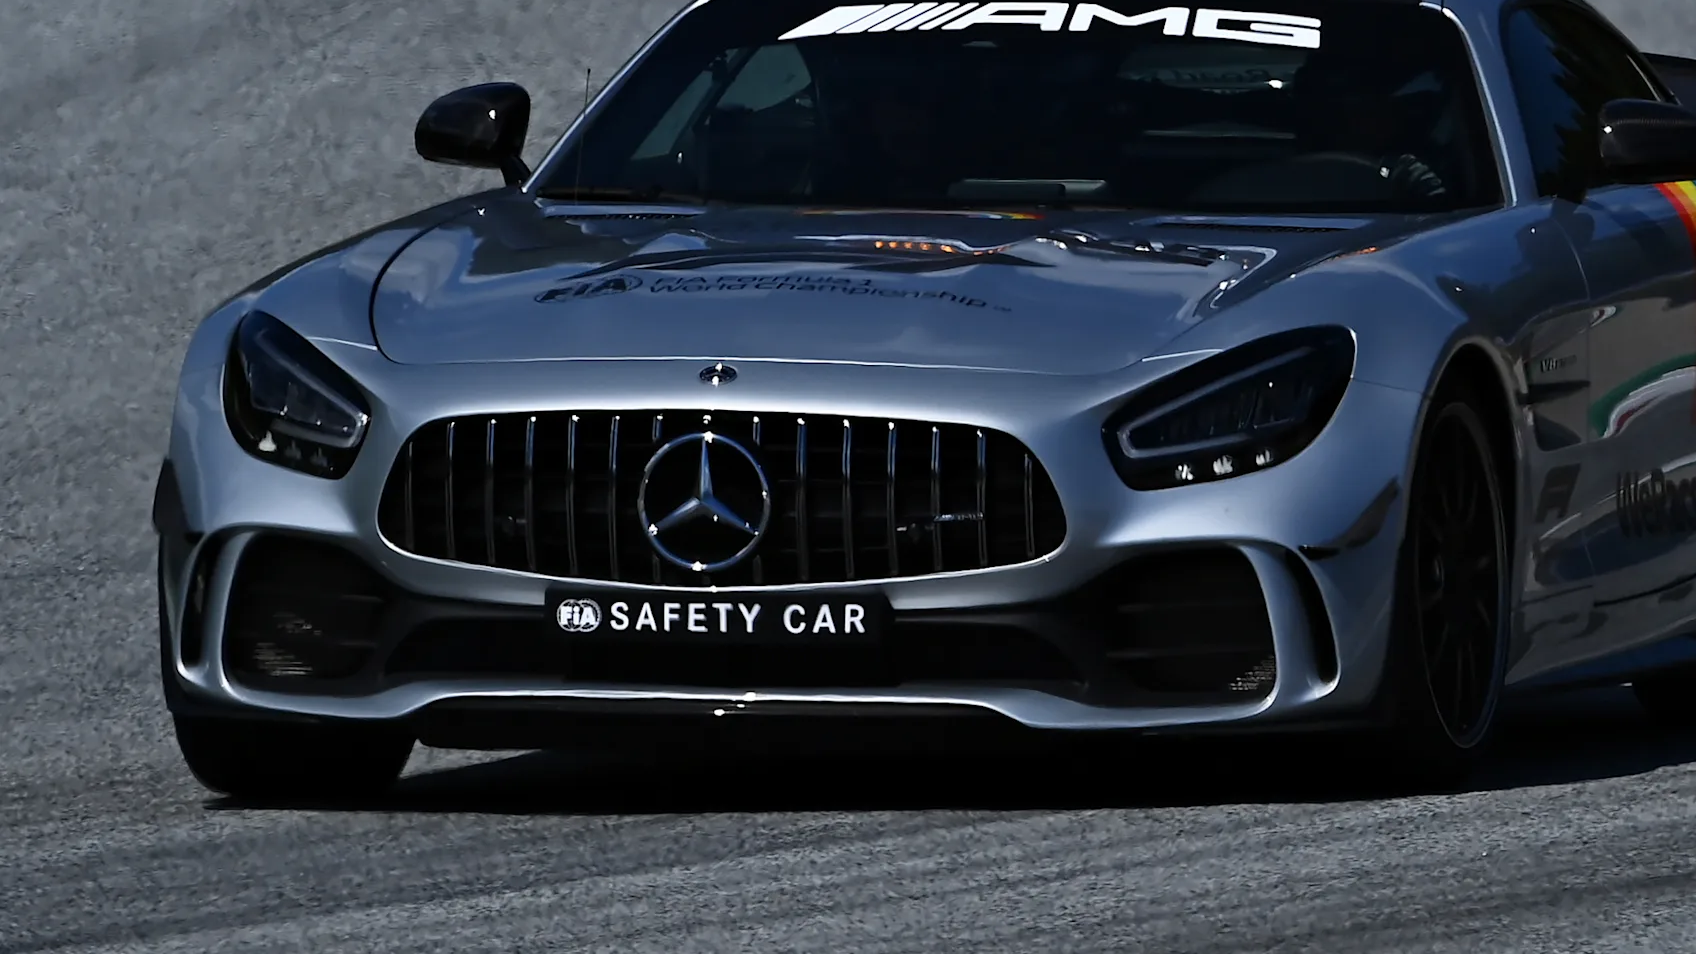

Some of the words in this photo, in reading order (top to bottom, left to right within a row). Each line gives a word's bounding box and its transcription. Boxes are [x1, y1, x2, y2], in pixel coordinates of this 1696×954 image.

[956, 2, 1322, 49] AMG
[609, 602, 762, 633] SAFETY
[782, 604, 866, 634] CAR
